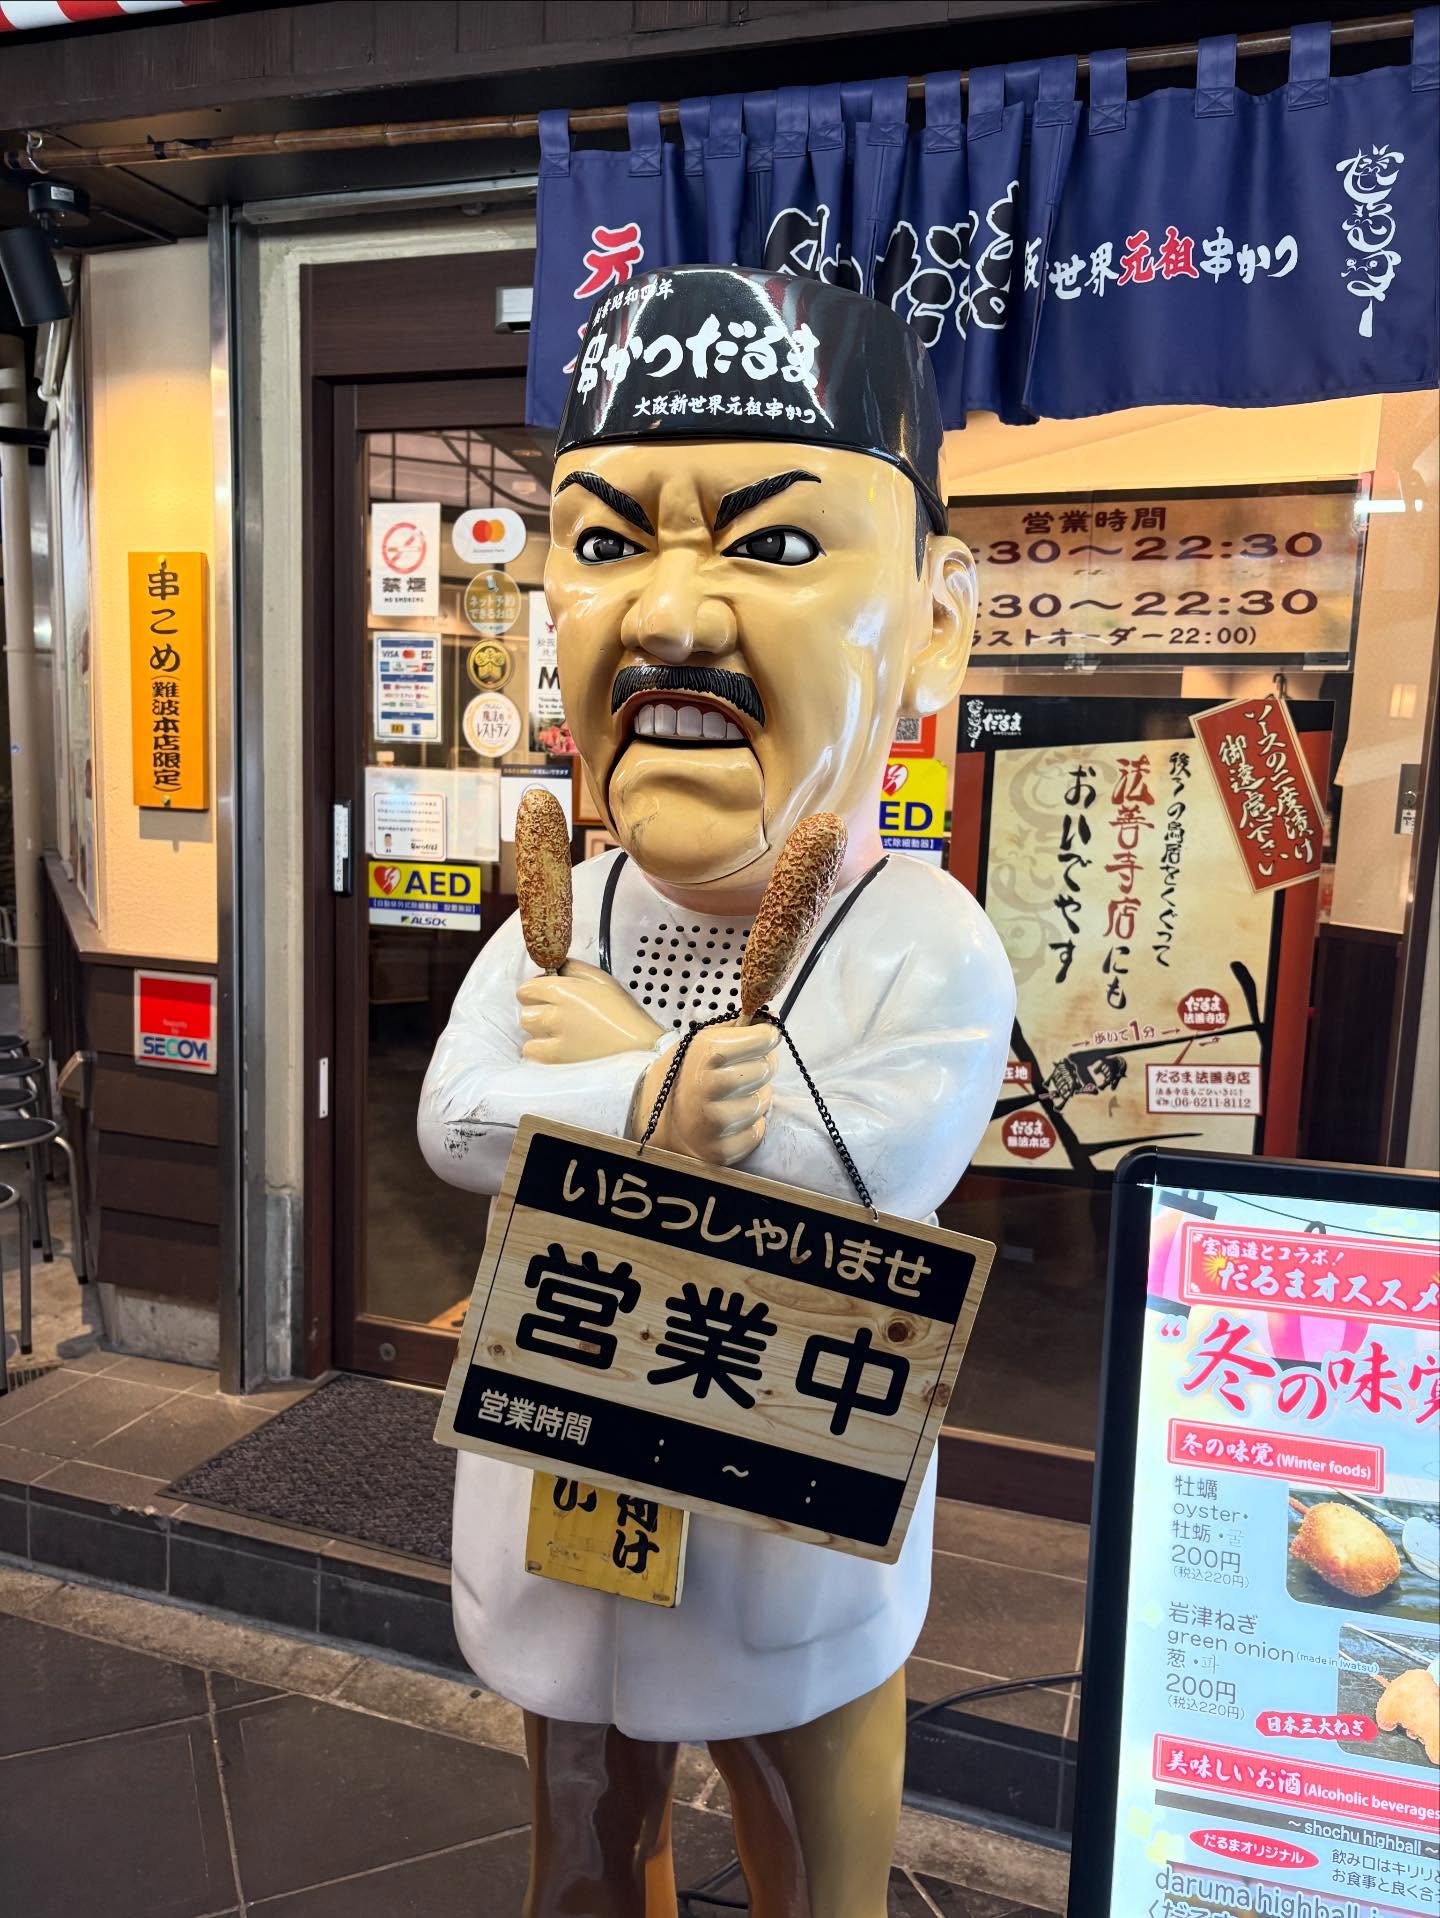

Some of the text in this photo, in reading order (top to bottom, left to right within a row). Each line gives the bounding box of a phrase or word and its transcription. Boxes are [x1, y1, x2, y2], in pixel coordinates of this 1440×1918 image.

[633, 394, 816, 425] 大阪新世界元祖串かつ
[1022, 508, 1167, 534] 営業時間
[382, 650, 400, 658] VISA
[880, 801, 933, 831] ED
[405, 871, 471, 897] AED
[1049, 765, 1097, 984] おいでやす
[1102, 753, 1155, 1010] 法善寺店にも
[411, 917, 447, 926] ALSOK
[1185, 995, 1221, 1011] だるま
[143, 1036, 208, 1061] SECOM
[1010, 1120, 1043, 1136] だるま
[562, 1159, 932, 1298] いらっしゃいませ
[1202, 1237, 1345, 1266] 宝酒造とコラボ!
[515, 1242, 911, 1436] 営業中
[477, 1389, 594, 1446] 営業時間
[1180, 1432, 1274, 1467] 冬の味覚
[1328, 1459, 1371, 1480] foods)
[1171, 1544, 1241, 1574] 200円
[1168, 1601, 1258, 1635] 岩津ねぎ
[1167, 1629, 1228, 1652] green
[1234, 1640, 1294, 1664] onion
[1329, 1657, 1338, 1666] in
[1166, 1674, 1236, 1704] 200円
[1267, 1716, 1365, 1737] 日本三大ねぎ
[1166, 1750, 1301, 1795] 美味しいお酒
[1304, 1782, 1369, 1808] (Alcoholic
[1203, 1833, 1304, 1864] だるまオリジナル
[1304, 1822, 1421, 1855] shochu highball
[1155, 1865, 1253, 1910] daruma
